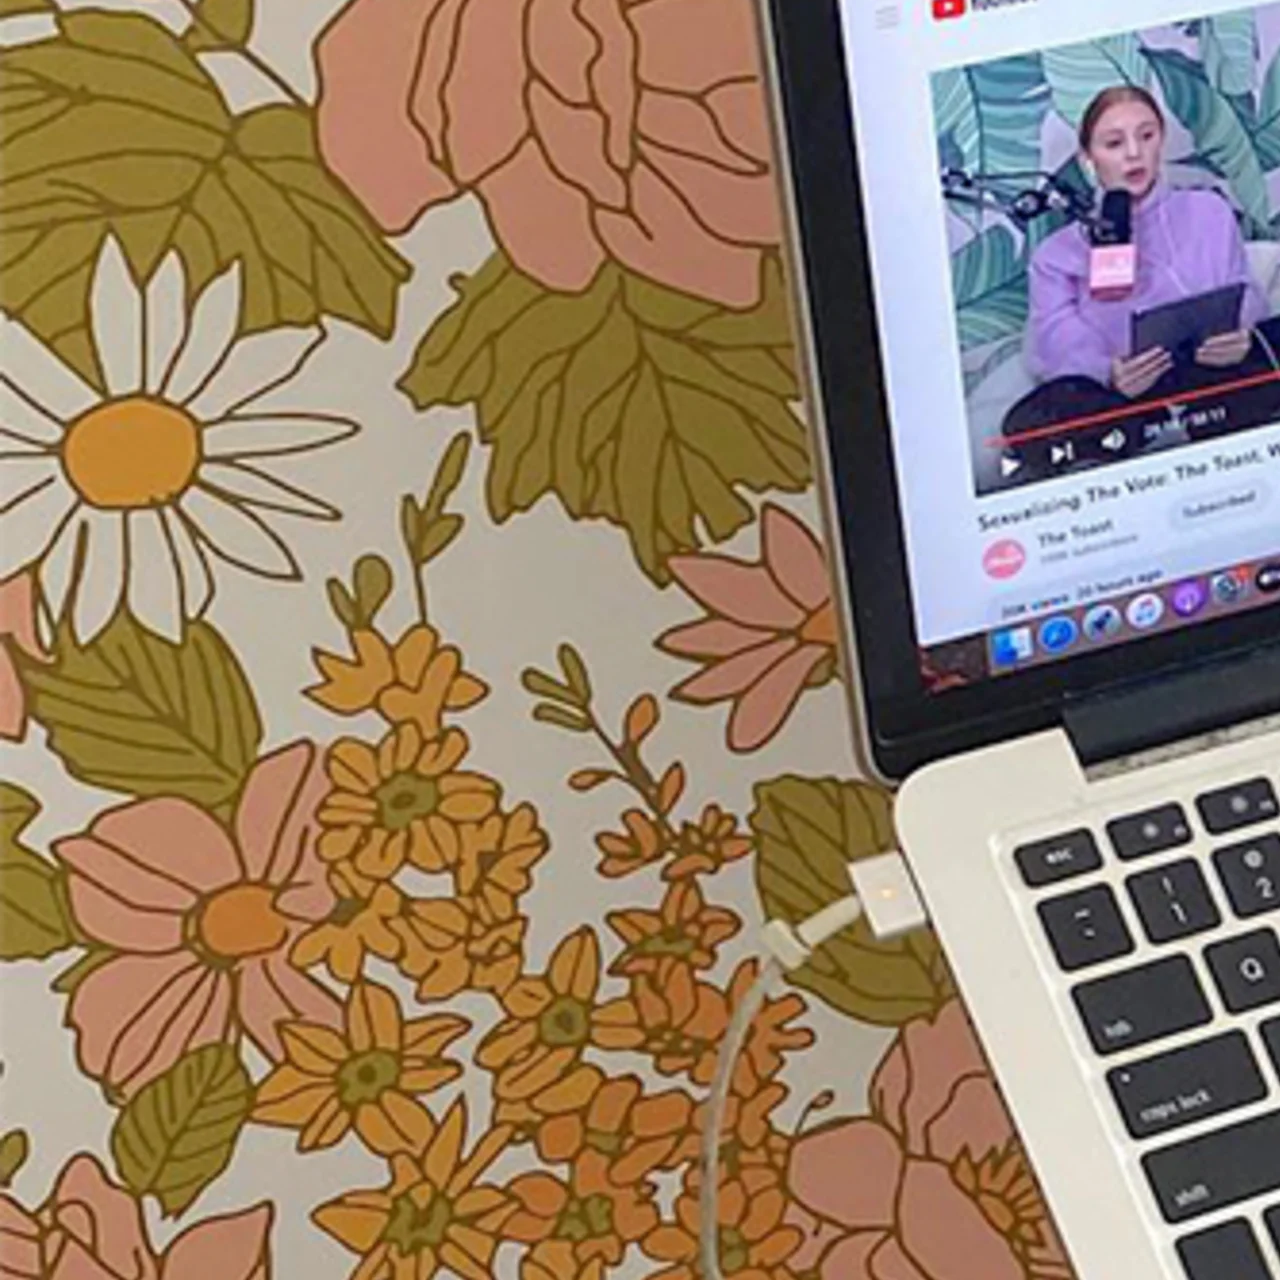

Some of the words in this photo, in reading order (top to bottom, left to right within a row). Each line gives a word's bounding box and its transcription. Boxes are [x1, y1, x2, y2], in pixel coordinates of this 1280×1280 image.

[977, 495, 1082, 532] Sexualizing
[1085, 486, 1121, 503] The
[1174, 463, 1209, 481] The
[1182, 490, 1256, 518] Subscribed
[1037, 532, 1067, 548] The
[1070, 519, 1114, 538] Toast
[1046, 848, 1073, 864] esc
[1255, 876, 1273, 898] 2
[1171, 902, 1187, 922] 1
[1240, 957, 1264, 981] Q
[1179, 1089, 1211, 1111] lock
[1174, 1184, 1210, 1208] shift
